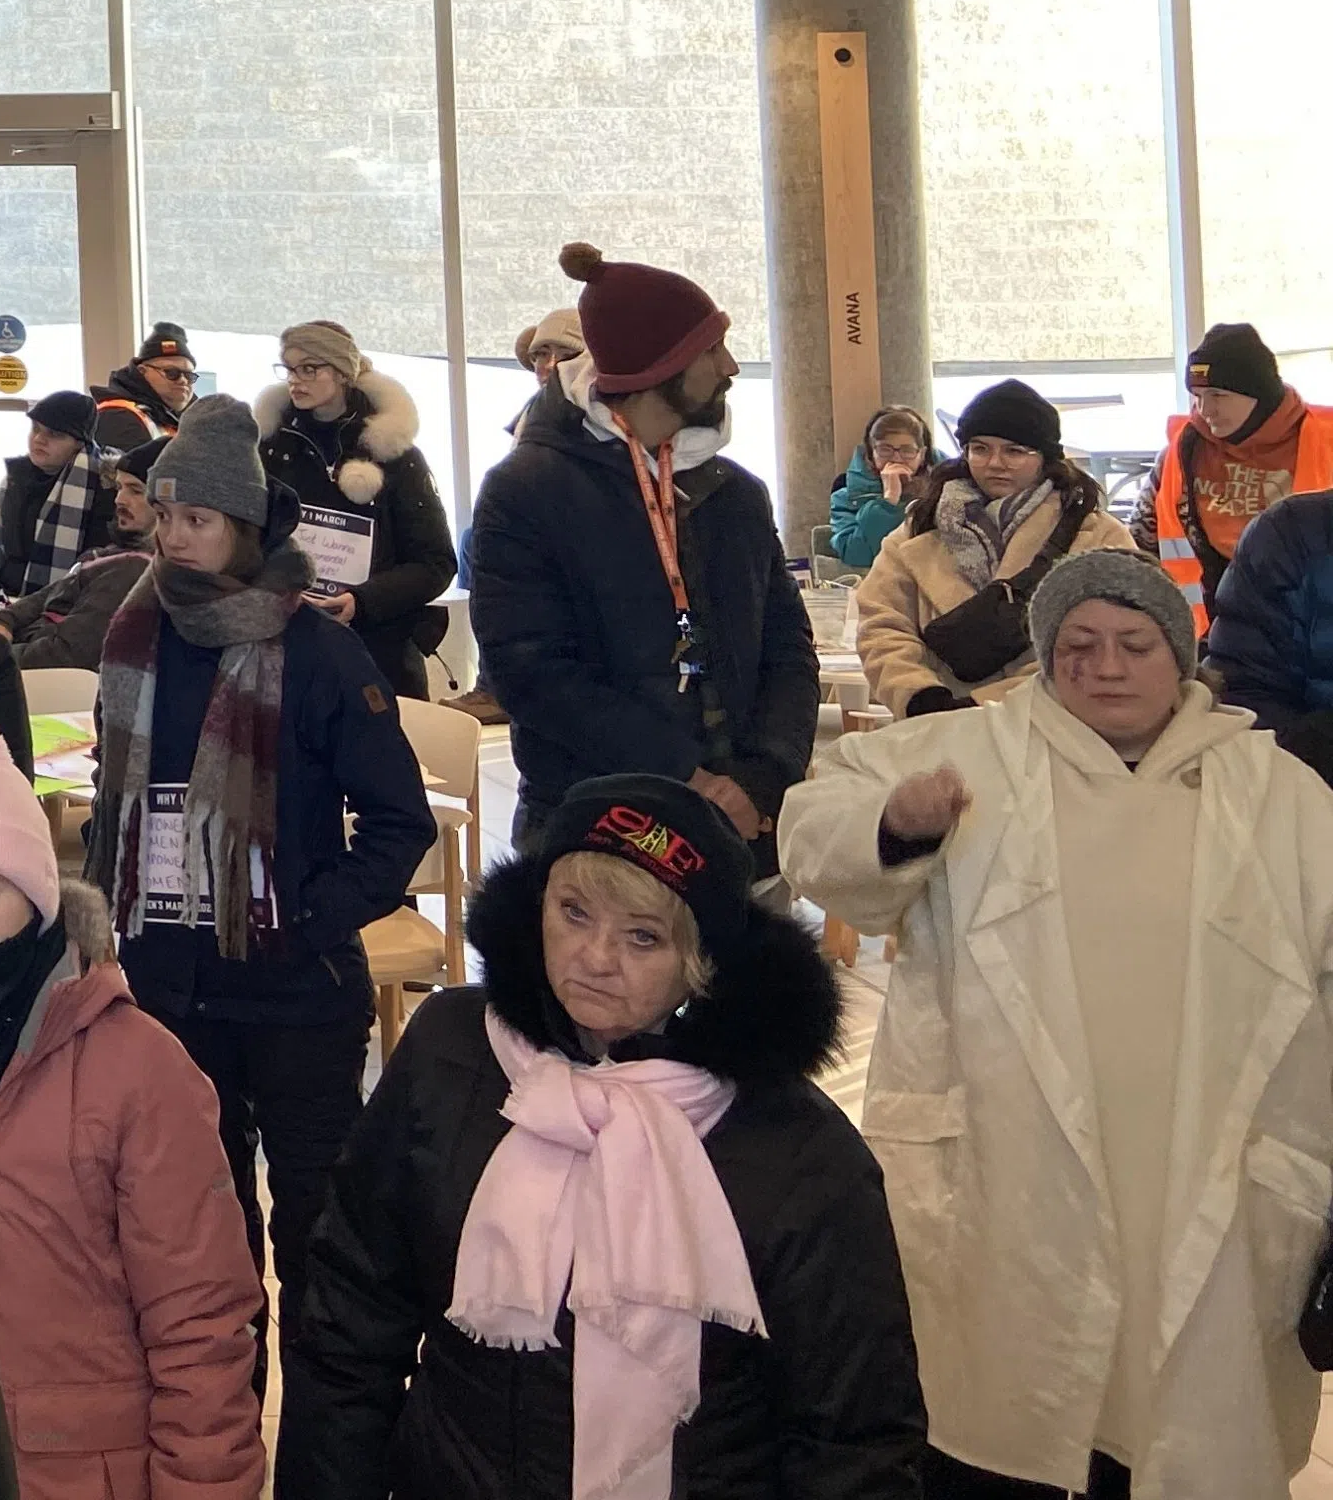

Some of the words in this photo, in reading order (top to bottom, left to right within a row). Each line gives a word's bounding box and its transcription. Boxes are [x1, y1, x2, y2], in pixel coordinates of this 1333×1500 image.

[845, 291, 862, 345] AVANA
[1224, 462, 1265, 483] THE
[1206, 497, 1261, 517] FACE
[315, 513, 347, 527] MARCH
[156, 792, 177, 806] WHY
